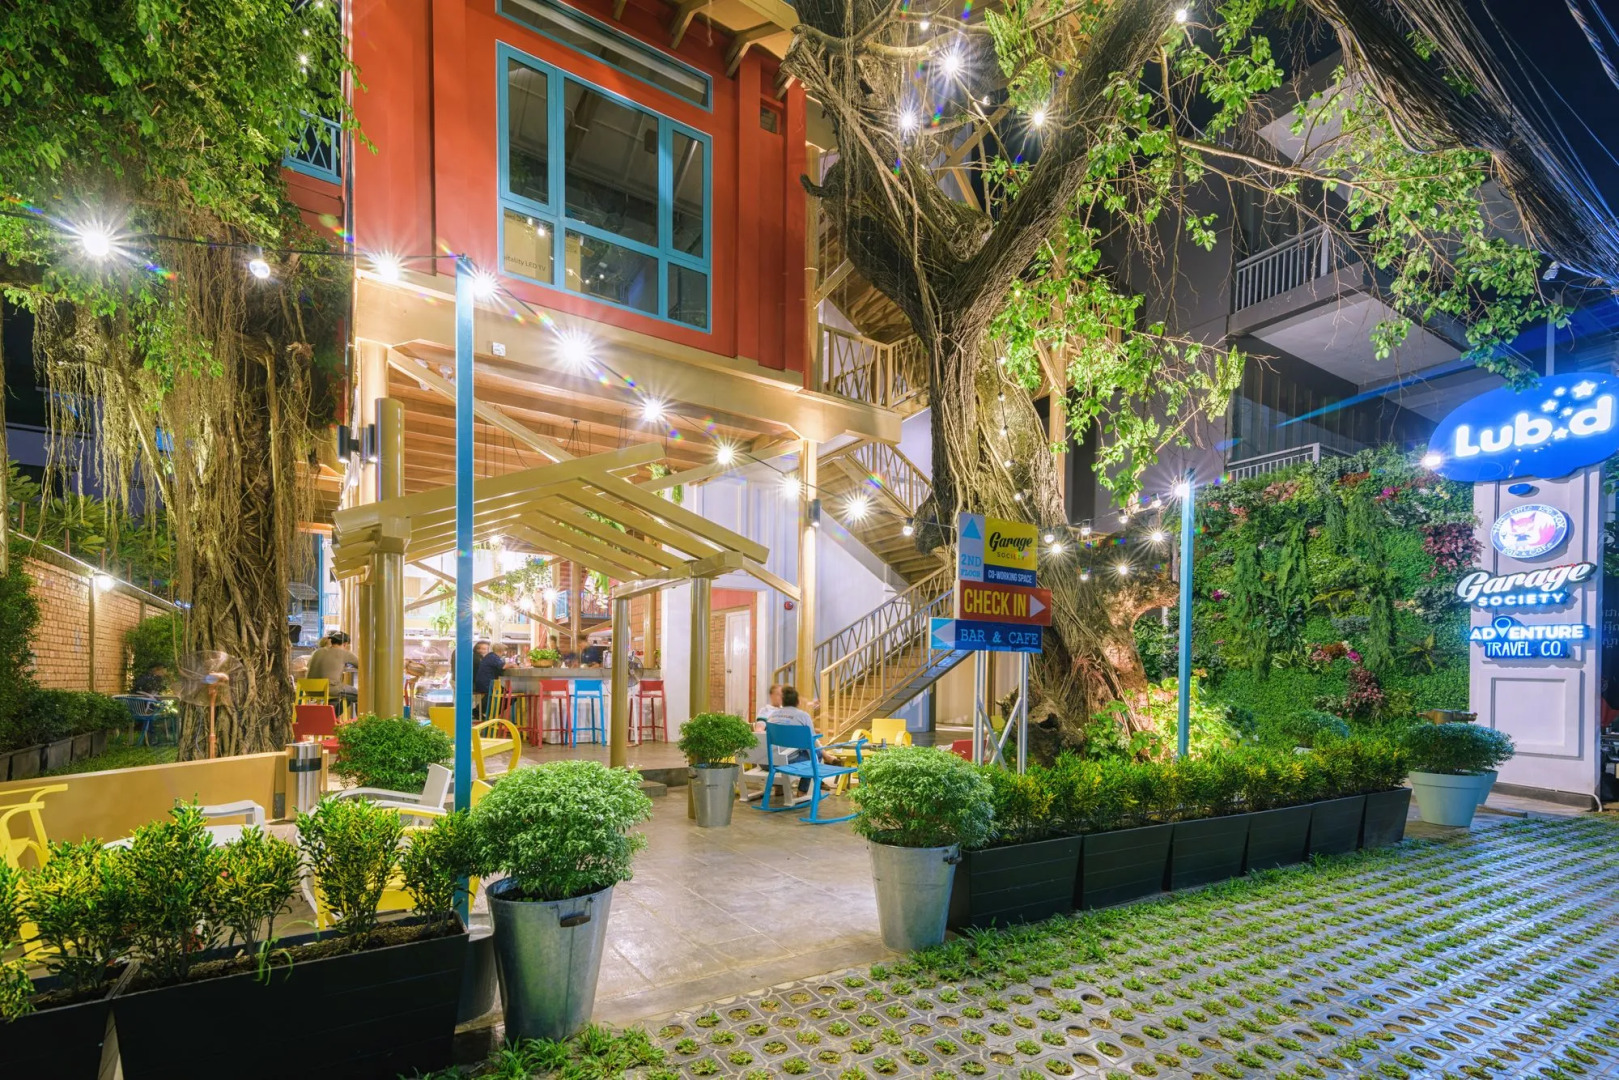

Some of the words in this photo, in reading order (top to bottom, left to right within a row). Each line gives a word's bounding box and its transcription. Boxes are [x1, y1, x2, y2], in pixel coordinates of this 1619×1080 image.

[526, 261, 537, 269] LED
[989, 531, 1033, 552] Garage
[961, 553, 982, 567] 2ND
[960, 568, 981, 577] FLOOR
[988, 570, 1017, 582] CO-WORKING
[1017, 573, 1033, 584] SPACE
[1456, 563, 1592, 602] Garage
[964, 588, 1010, 616] CHECK
[1014, 594, 1027, 617] IN
[1478, 592, 1565, 607] SOCIETY
[960, 628, 986, 642] BAR
[992, 632, 1001, 643] &
[1008, 632, 1039, 645] CAFE
[1469, 618, 1585, 640] ADVENTURE
[1486, 641, 1532, 656] TRAVEL
[1541, 640, 1564, 657] CO.
